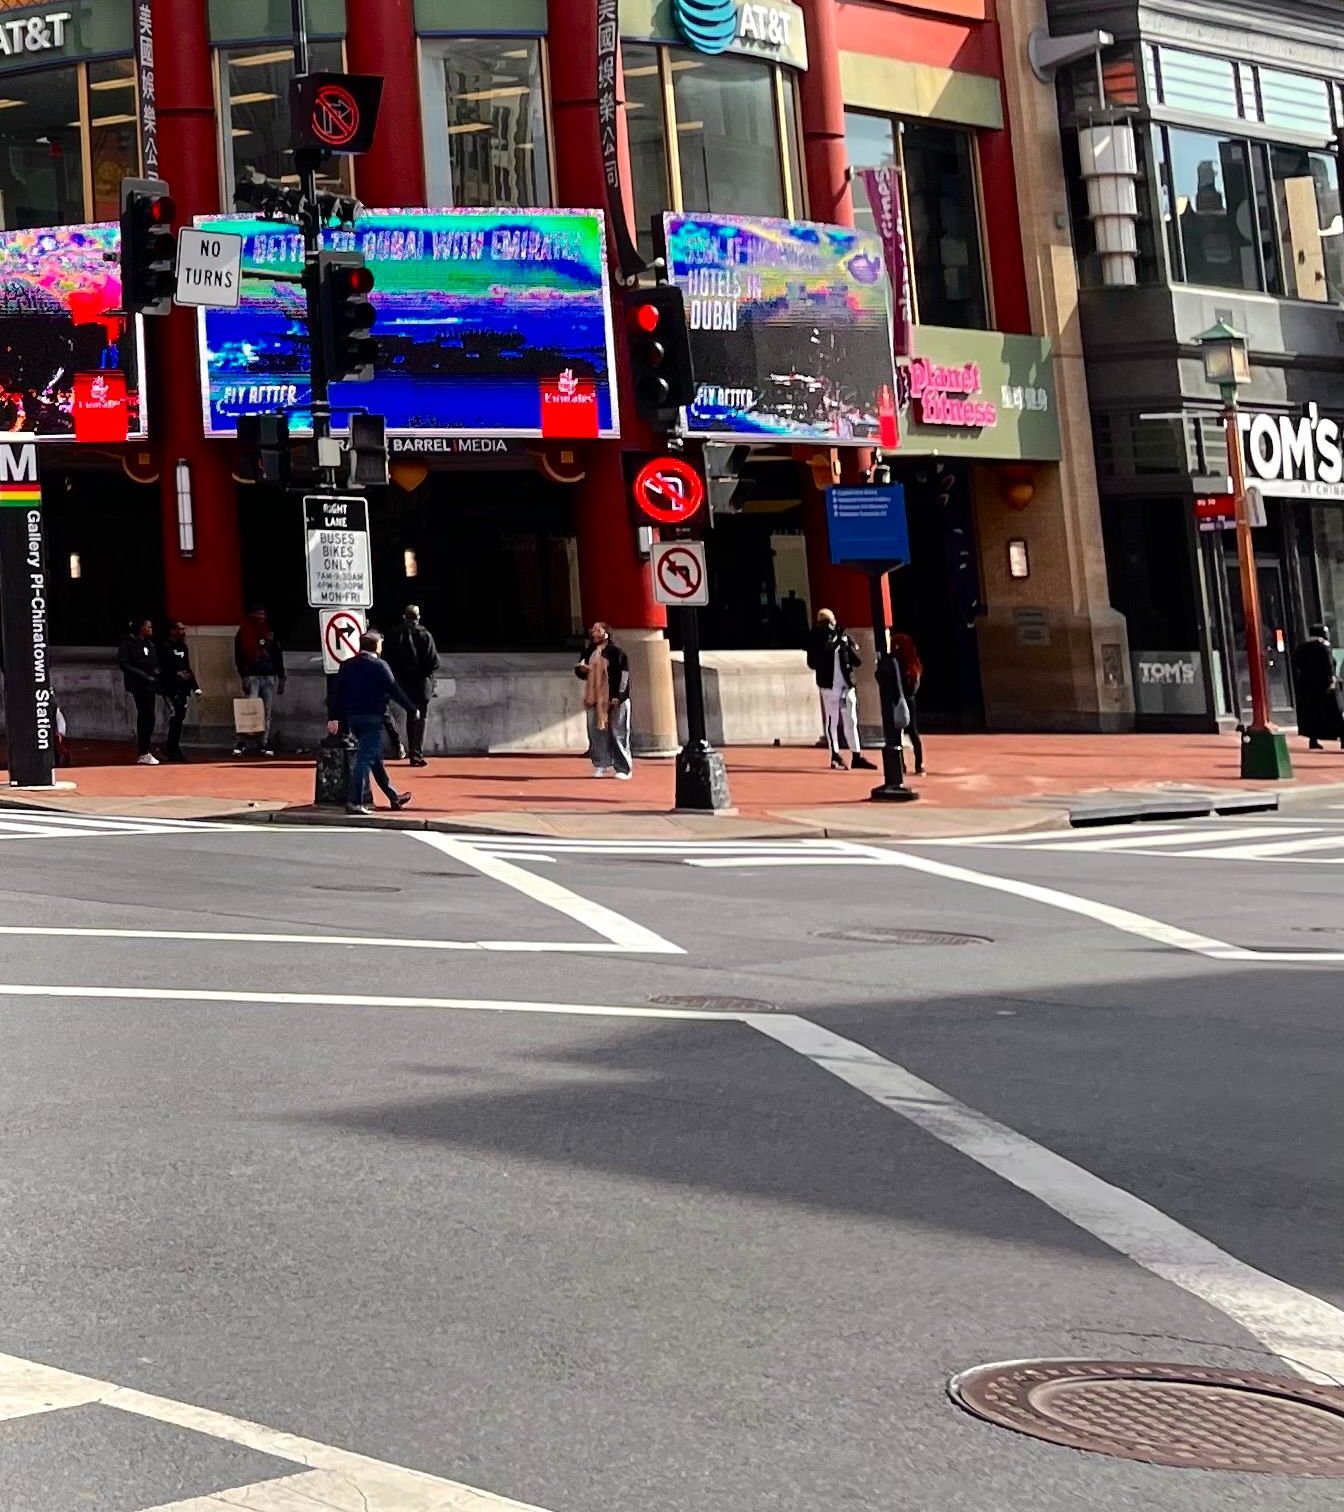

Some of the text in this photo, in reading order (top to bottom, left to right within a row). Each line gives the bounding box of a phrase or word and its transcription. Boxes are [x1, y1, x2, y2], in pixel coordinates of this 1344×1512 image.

[739, 2, 792, 46] AT&T
[199, 239, 222, 258] NO
[185, 267, 234, 289] TURNS
[688, 267, 742, 300] HOTELS
[690, 299, 738, 332] DUBAI
[910, 357, 983, 398] planet
[921, 388, 998, 428] fitness
[393, 438, 451, 453] BARREL
[458, 438, 508, 453] MEDIA
[1235, 401, 1343, 484] TOM'S
[323, 503, 348, 515] RIGHT
[325, 516, 348, 528] LANE
[320, 532, 355, 545] BUSES
[322, 546, 354, 558] BIKES
[323, 558, 354, 571] ONLY
[27, 509, 42, 568] Gallery
[35, 688, 52, 750] Station
[1138, 659, 1195, 678] TOM'S
